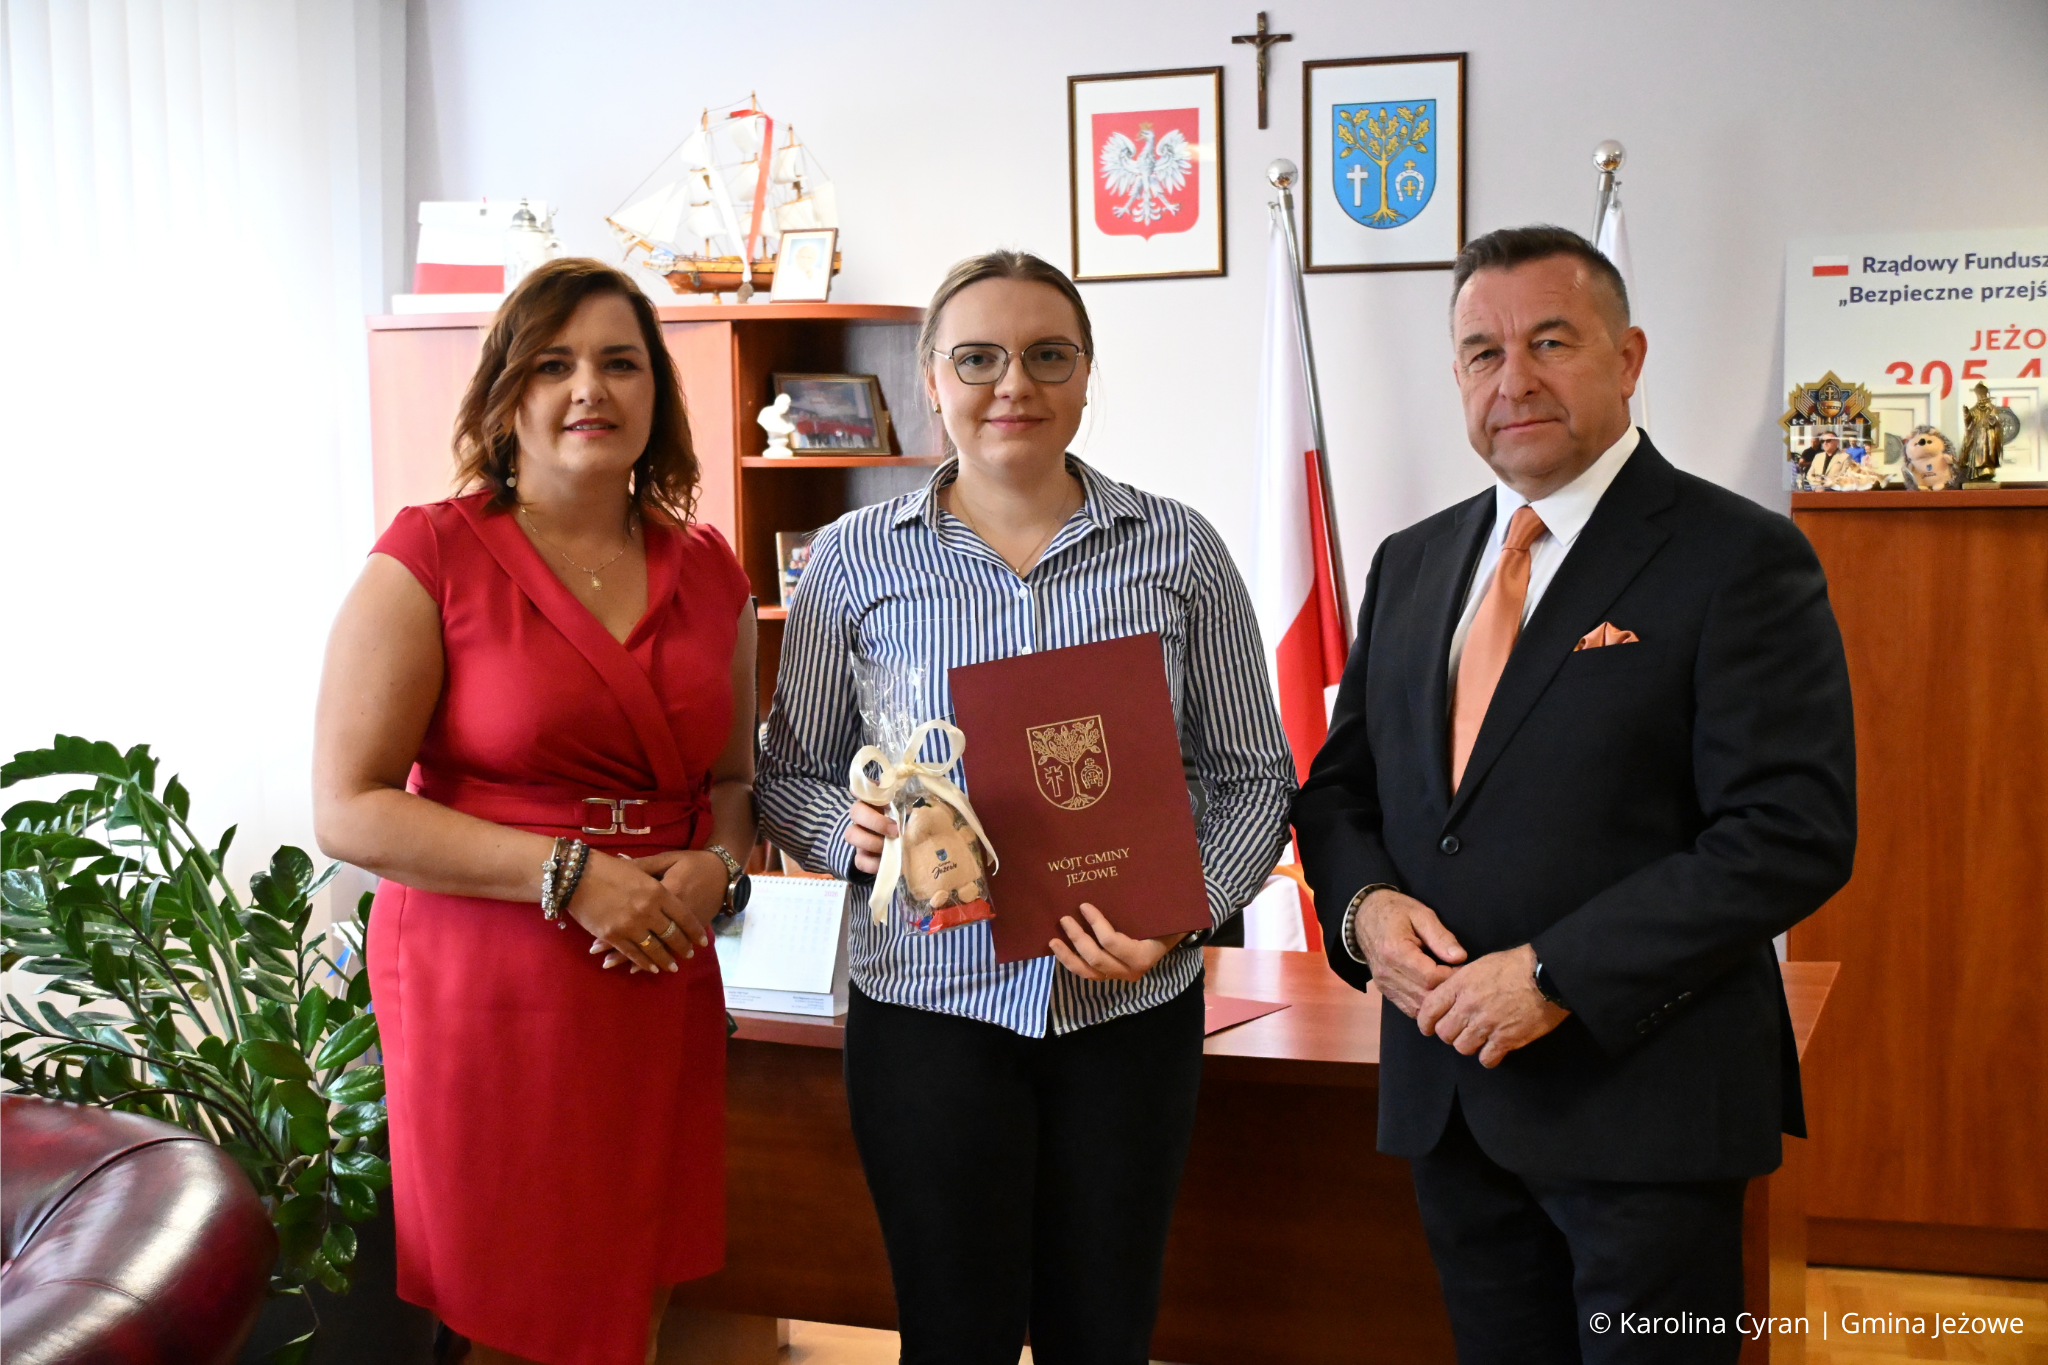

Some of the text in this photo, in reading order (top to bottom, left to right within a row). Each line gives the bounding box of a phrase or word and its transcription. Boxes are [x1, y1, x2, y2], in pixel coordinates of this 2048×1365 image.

[1862, 252, 2048, 276] Rządowy Fundusz
[1981, 281, 2047, 302] przejś
[1970, 324, 2047, 351] JEŻO
[1048, 847, 1130, 872] WÓJT GMINY
[1066, 866, 1118, 887] JEŻOWE
